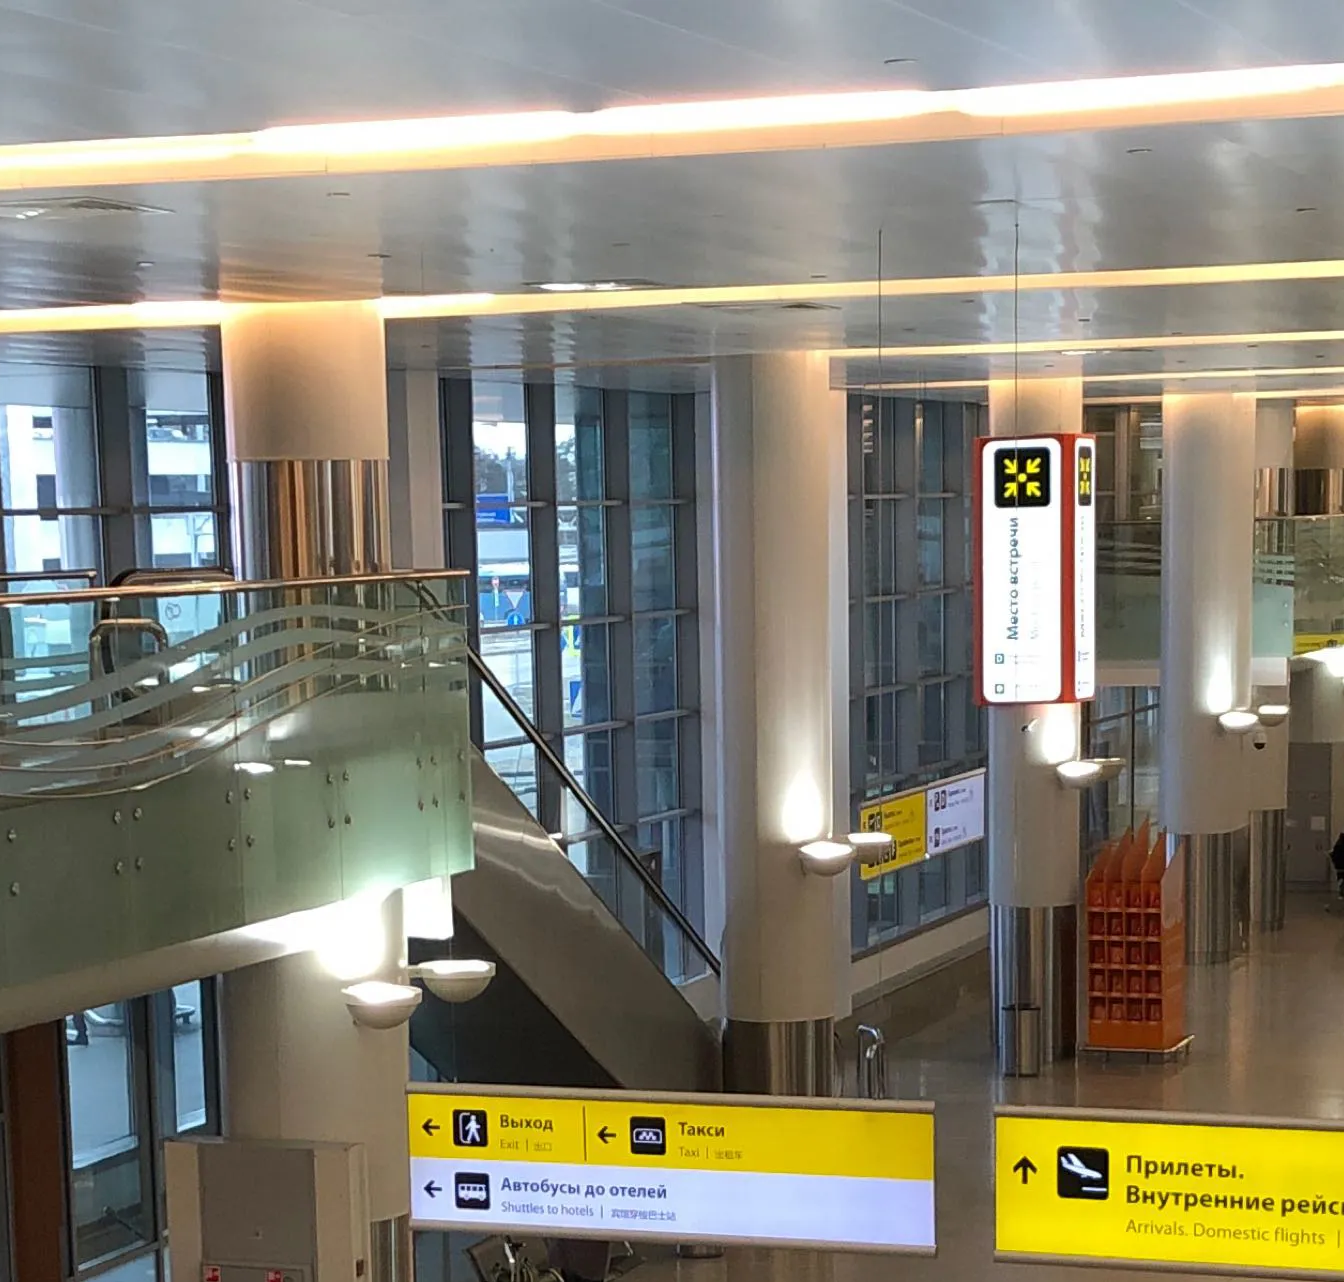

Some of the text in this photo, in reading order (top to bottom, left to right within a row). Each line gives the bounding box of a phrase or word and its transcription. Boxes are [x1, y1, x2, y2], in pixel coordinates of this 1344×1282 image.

[1006, 517, 1022, 641] Место встречи
[499, 1114, 554, 1132] Выход
[677, 1121, 725, 1137] Такси
[499, 1139, 520, 1151] Exit
[678, 1146, 700, 1158] Taxi
[1126, 1154, 1244, 1180] Прилеты.
[500, 1176, 667, 1199] Автобусы до отелей
[1126, 1184, 1275, 1212] Внутренние
[500, 1201, 594, 1217] Shuttles to hotels
[1125, 1218, 1326, 1247] Arrivals. Domestic flights
